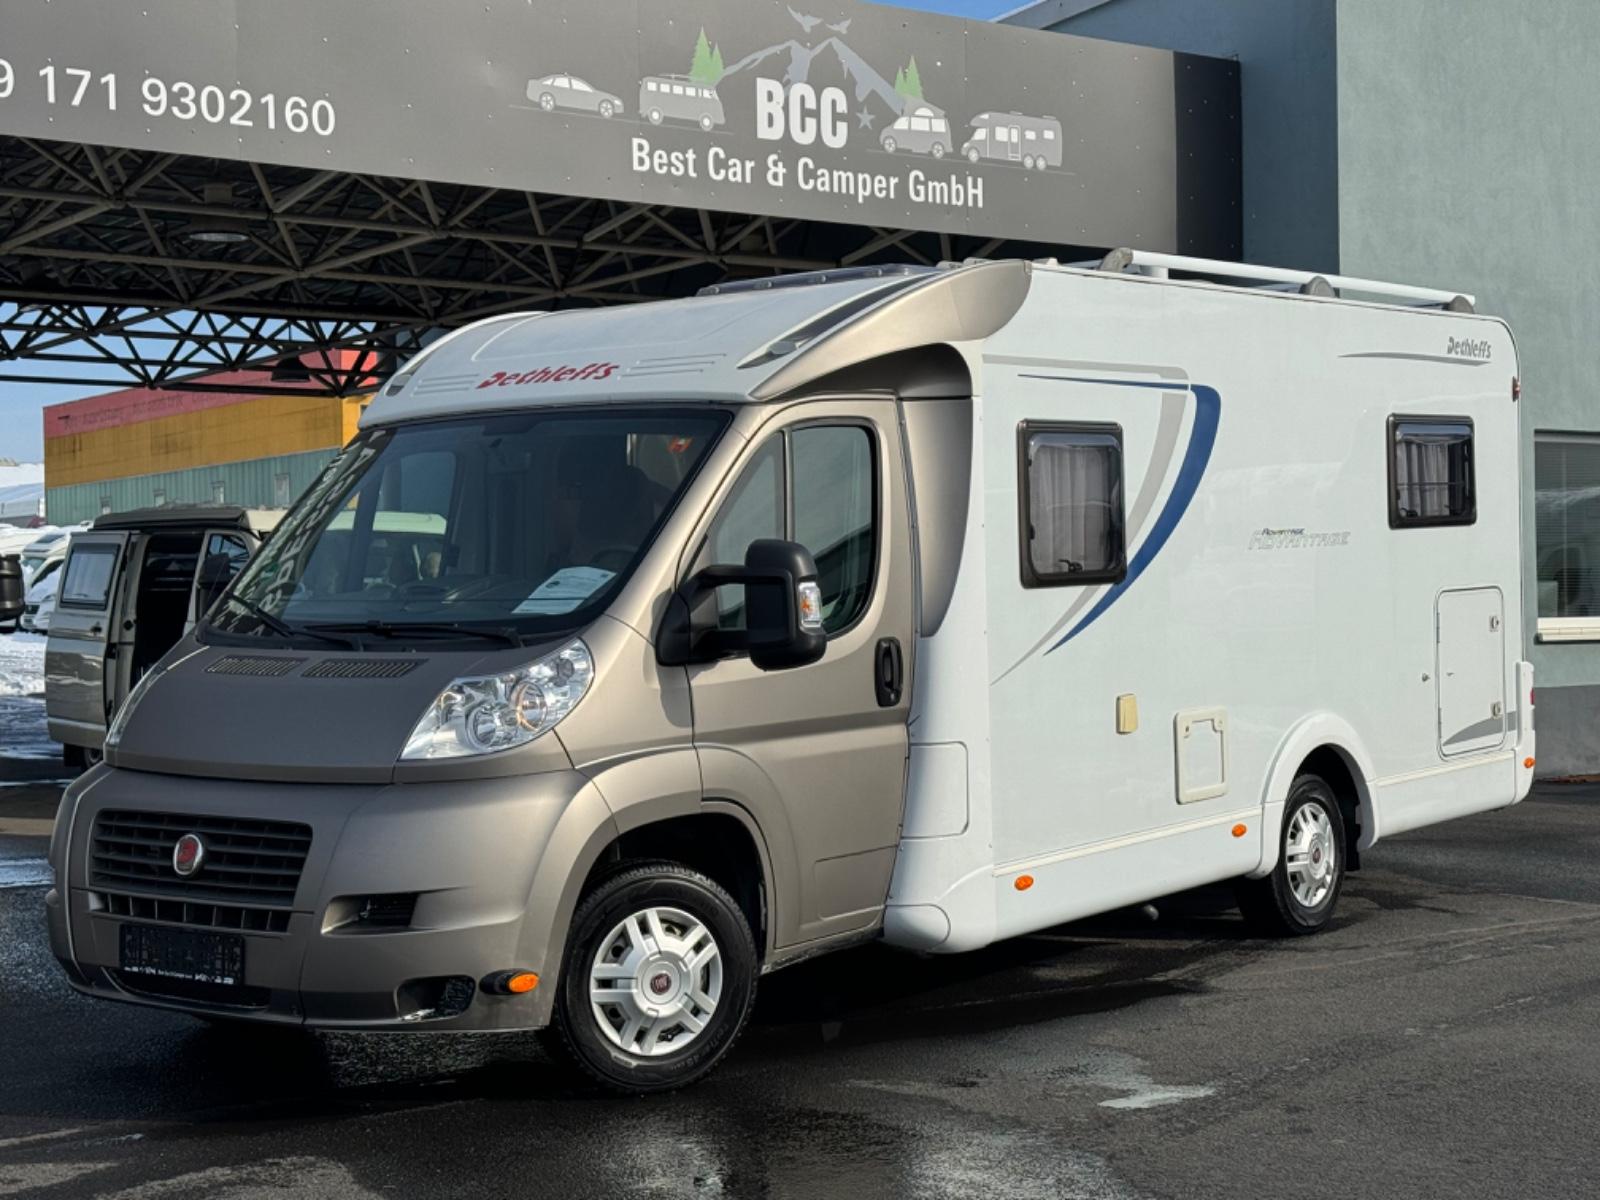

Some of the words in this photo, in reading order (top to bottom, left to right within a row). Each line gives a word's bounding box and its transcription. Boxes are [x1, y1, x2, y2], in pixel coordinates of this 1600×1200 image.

[39, 66, 117, 110] 171
[142, 78, 336, 137] 9302160
[757, 78, 848, 149] BCC
[632, 137, 697, 178] Best
[708, 146, 755, 184] Car
[766, 154, 786, 186] &
[798, 157, 898, 202] Camper
[909, 170, 983, 209] GmbH
[476, 363, 619, 389] Dethleffs
[1447, 336, 1491, 358] Dethleffs
